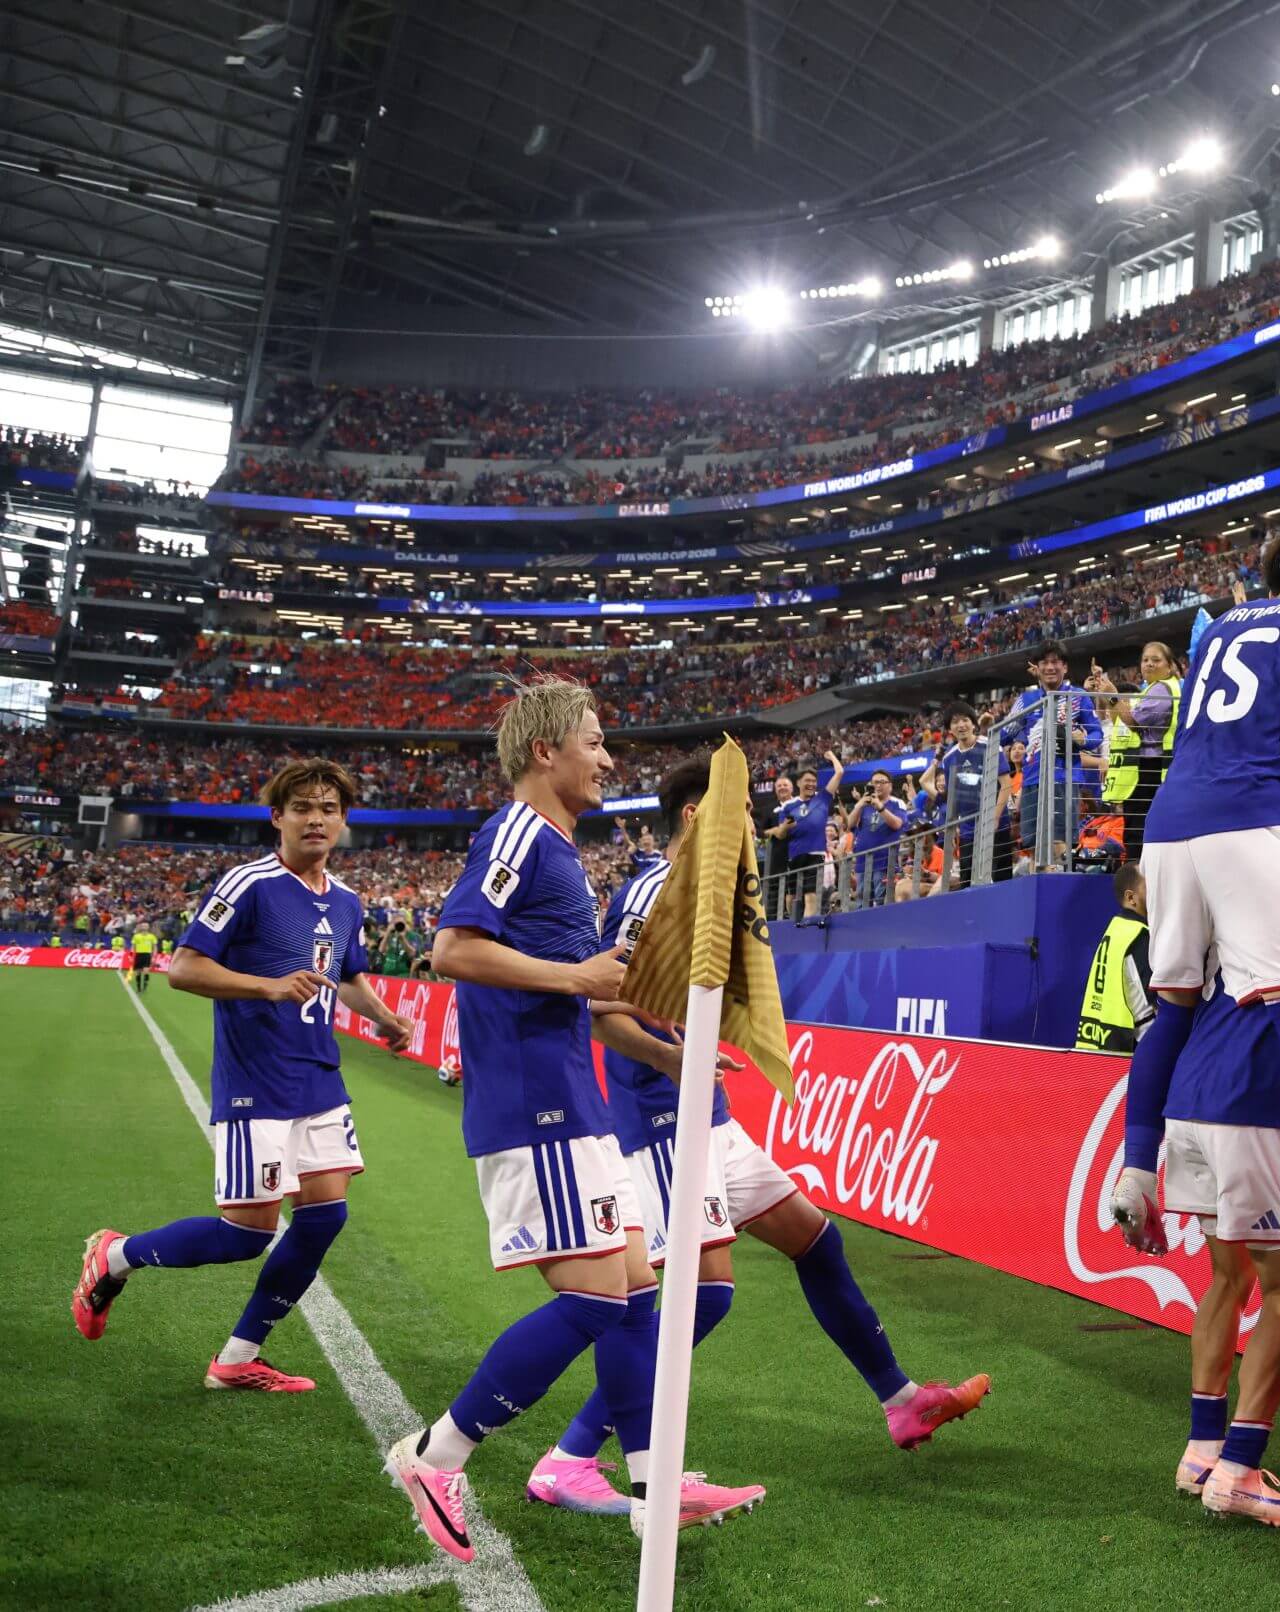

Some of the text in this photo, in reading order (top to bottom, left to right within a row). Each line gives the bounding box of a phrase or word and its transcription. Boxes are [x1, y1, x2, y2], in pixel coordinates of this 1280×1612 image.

[1030, 404, 1073, 431] DALLAS
[804, 458, 914, 497] FIFA WORLD CUP 2026
[1144, 475, 1266, 523] FIFA WORLD CUP 2026
[849, 520, 894, 539] DALLAS
[394, 552, 459, 563] DALLAS
[1186, 627, 1280, 729] 15
[63, 948, 127, 968] Coca-Cola
[301, 985, 332, 1025] 24
[896, 997, 945, 1035] FIFA
[765, 1031, 963, 1226] Coca-Cola
